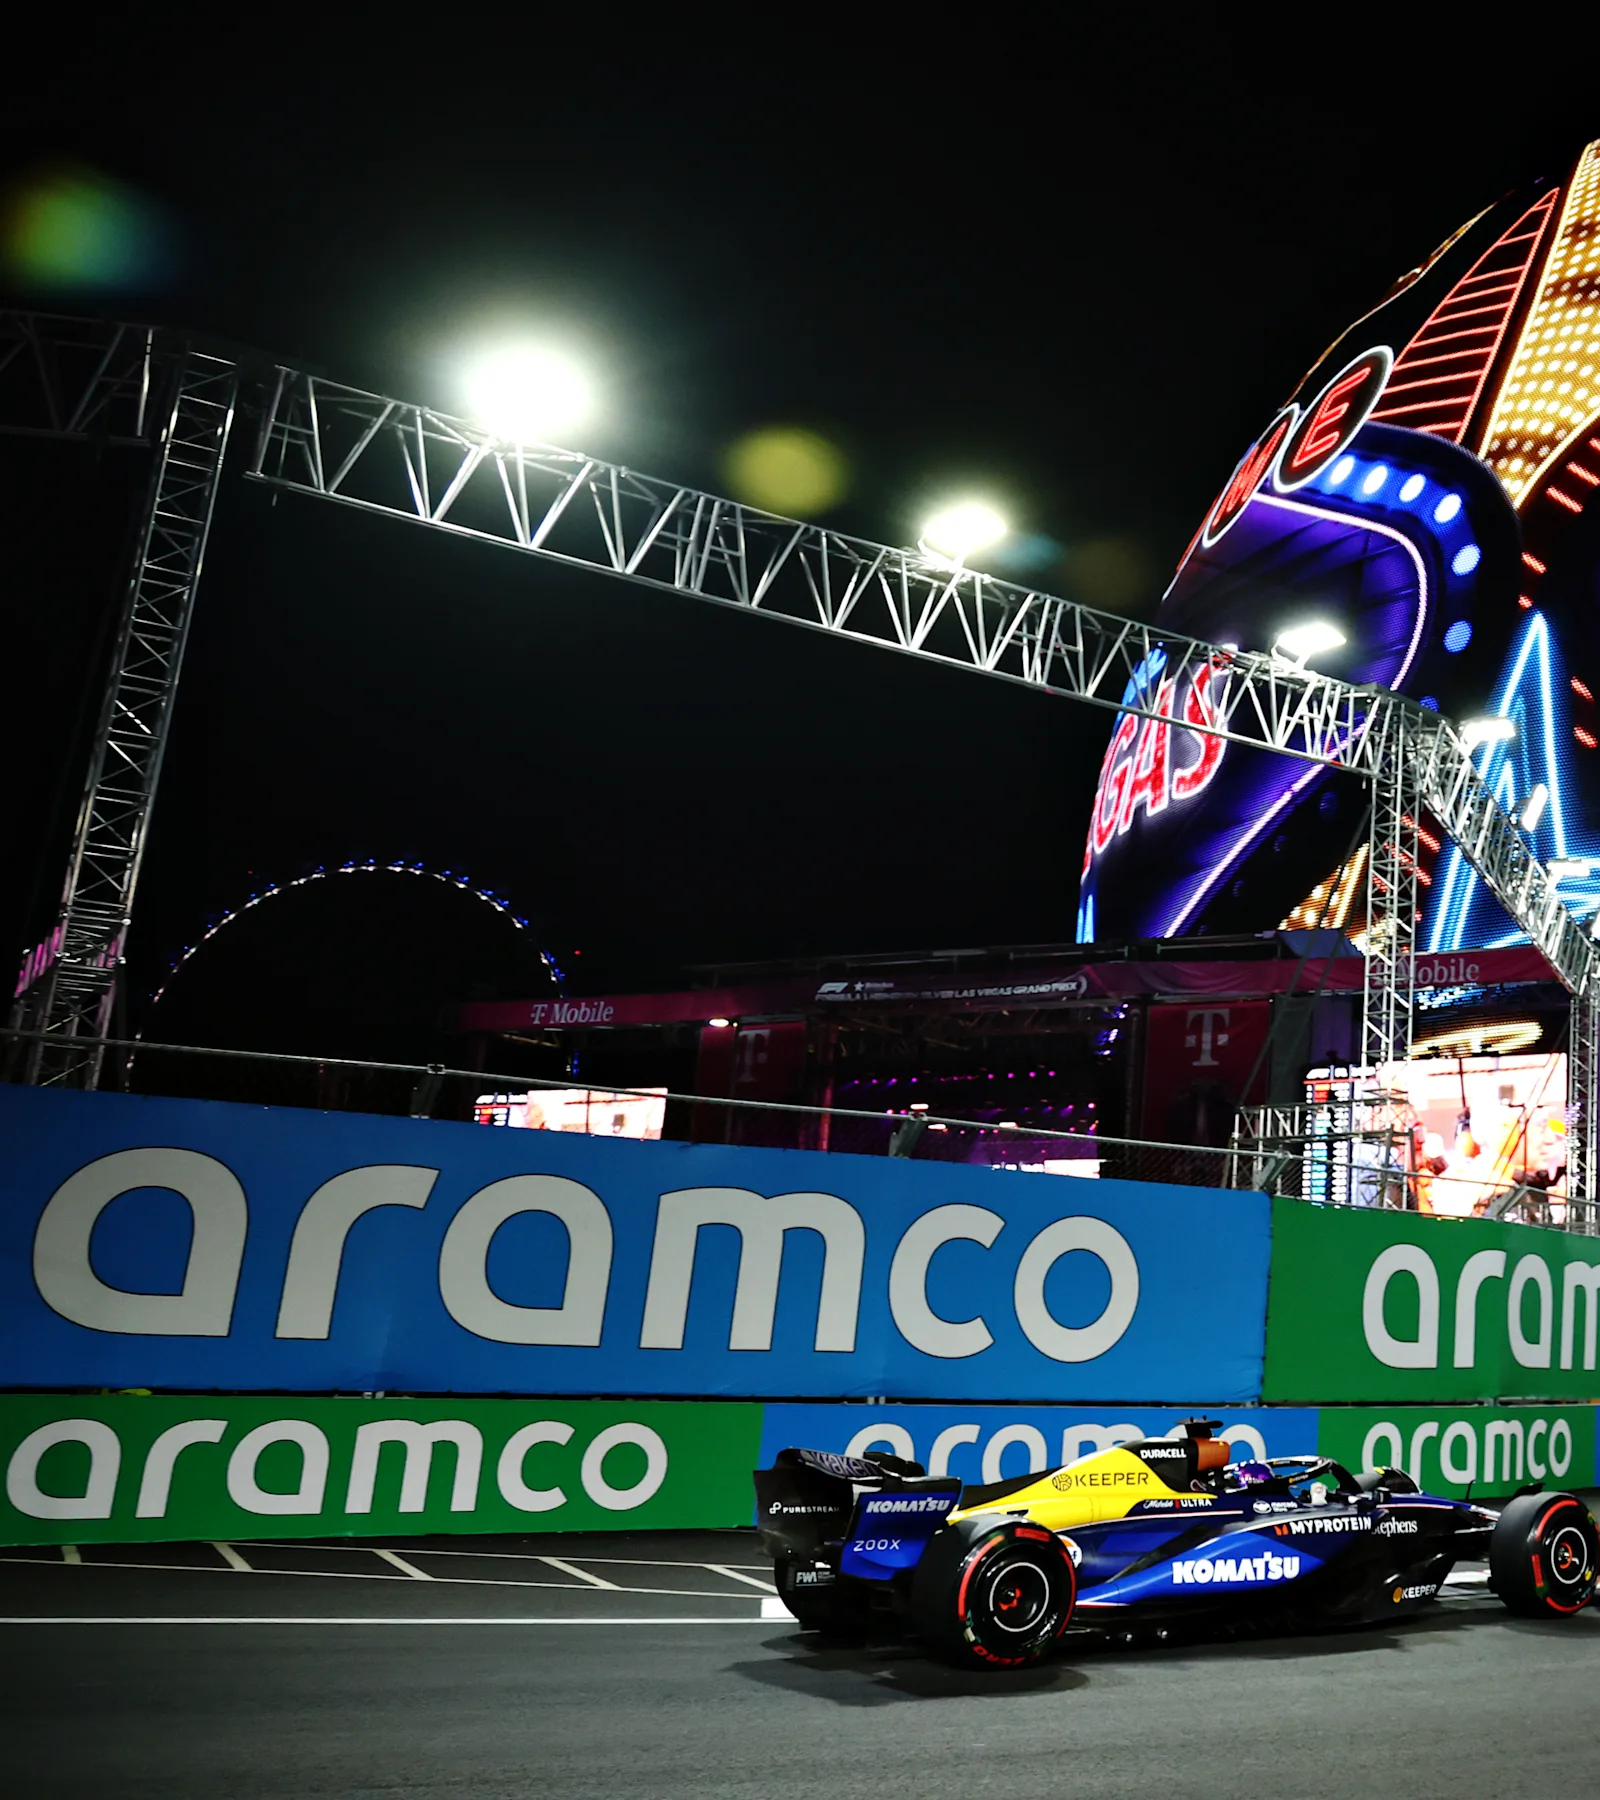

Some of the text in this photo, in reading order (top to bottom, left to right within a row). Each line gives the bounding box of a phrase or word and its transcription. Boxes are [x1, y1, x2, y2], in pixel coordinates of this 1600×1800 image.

[1082, 652, 1230, 880] GAS
[954, 987, 976, 998] LAS
[976, 986, 1013, 997] VEGAS
[1012, 983, 1052, 995] GRAND
[1051, 981, 1079, 992] PRIX
[549, 1001, 614, 1025] Mobile
[31, 1145, 1141, 1364] aramco
[1140, 1448, 1187, 1460] DURACELL
[1361, 1418, 1572, 1485] aramco
[2, 1418, 669, 1520] aramco
[842, 1422, 1267, 1505] aramo
[1075, 1471, 1149, 1487] KEEPER
[782, 1505, 840, 1514] PURESTREAM
[866, 1497, 950, 1513] KOMATSU
[1180, 1498, 1213, 1508] ULTRA
[1289, 1515, 1372, 1535] MYPROTEIN
[1172, 1551, 1300, 1584] KOMATSU
[1401, 1583, 1437, 1600] KEEPER
